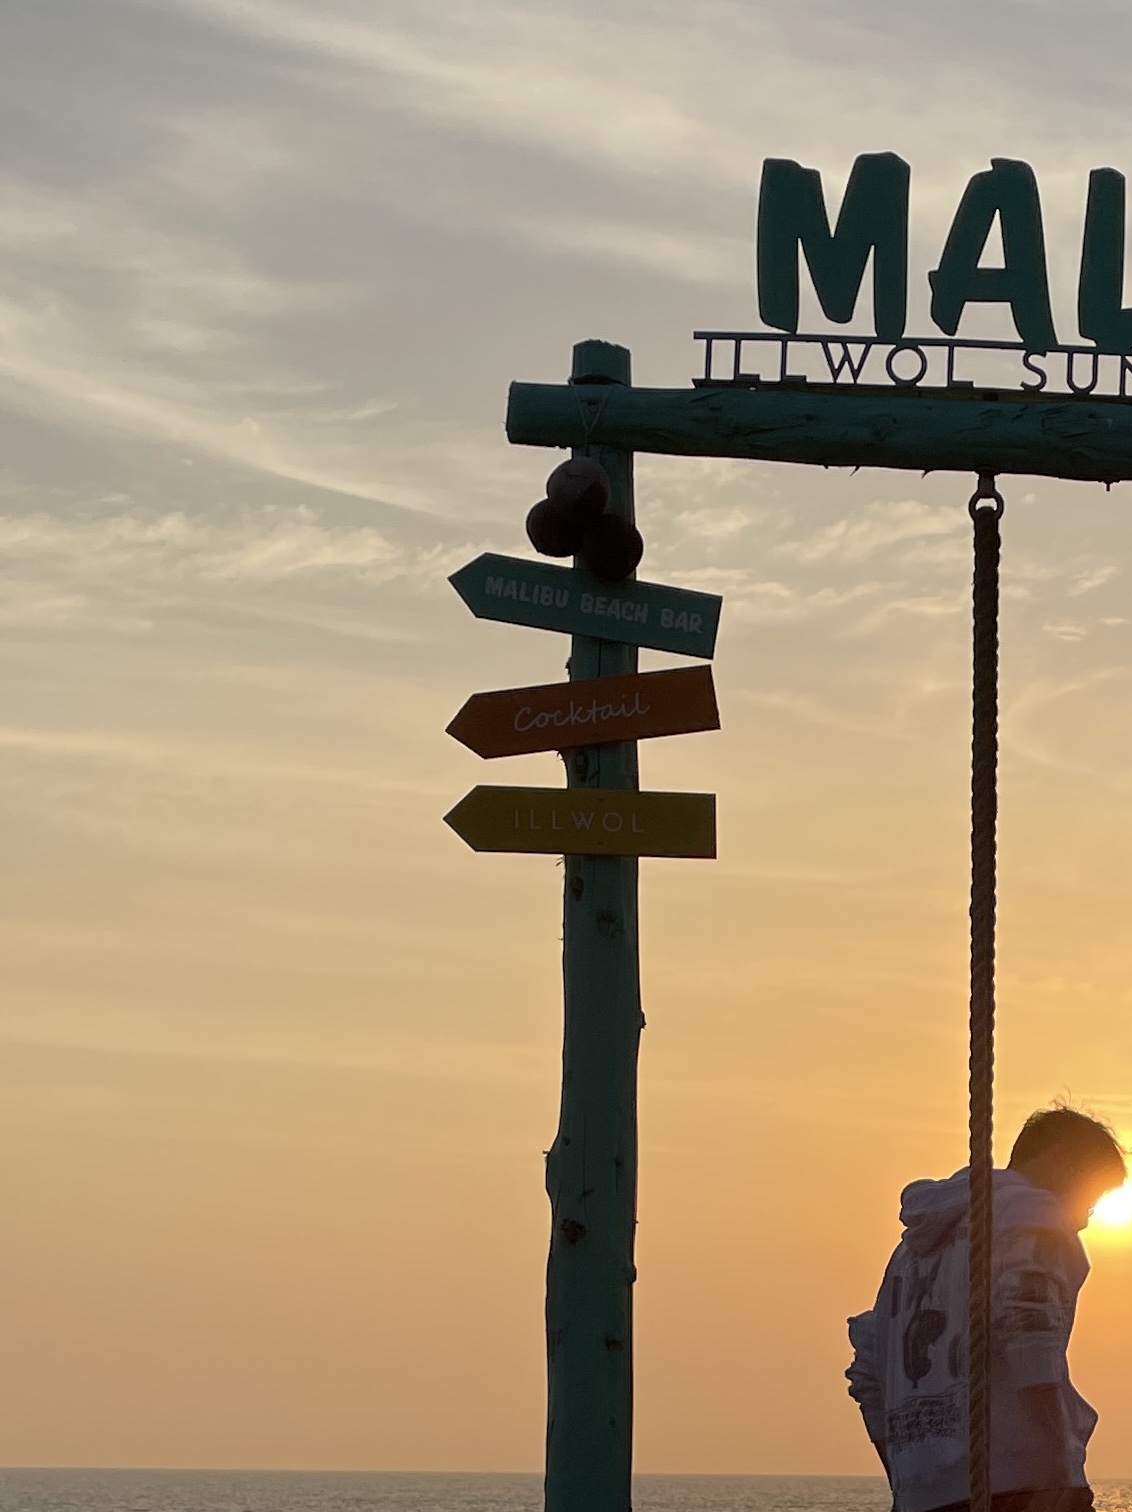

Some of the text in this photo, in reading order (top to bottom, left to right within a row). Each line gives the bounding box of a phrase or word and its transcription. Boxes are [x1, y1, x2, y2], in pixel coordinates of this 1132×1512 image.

[704, 338, 975, 387] ILLWOL
[485, 576, 703, 634] MALIBU BEACH BAR
[513, 692, 650, 732] Cocktail
[514, 808, 644, 833] ILLWOL
